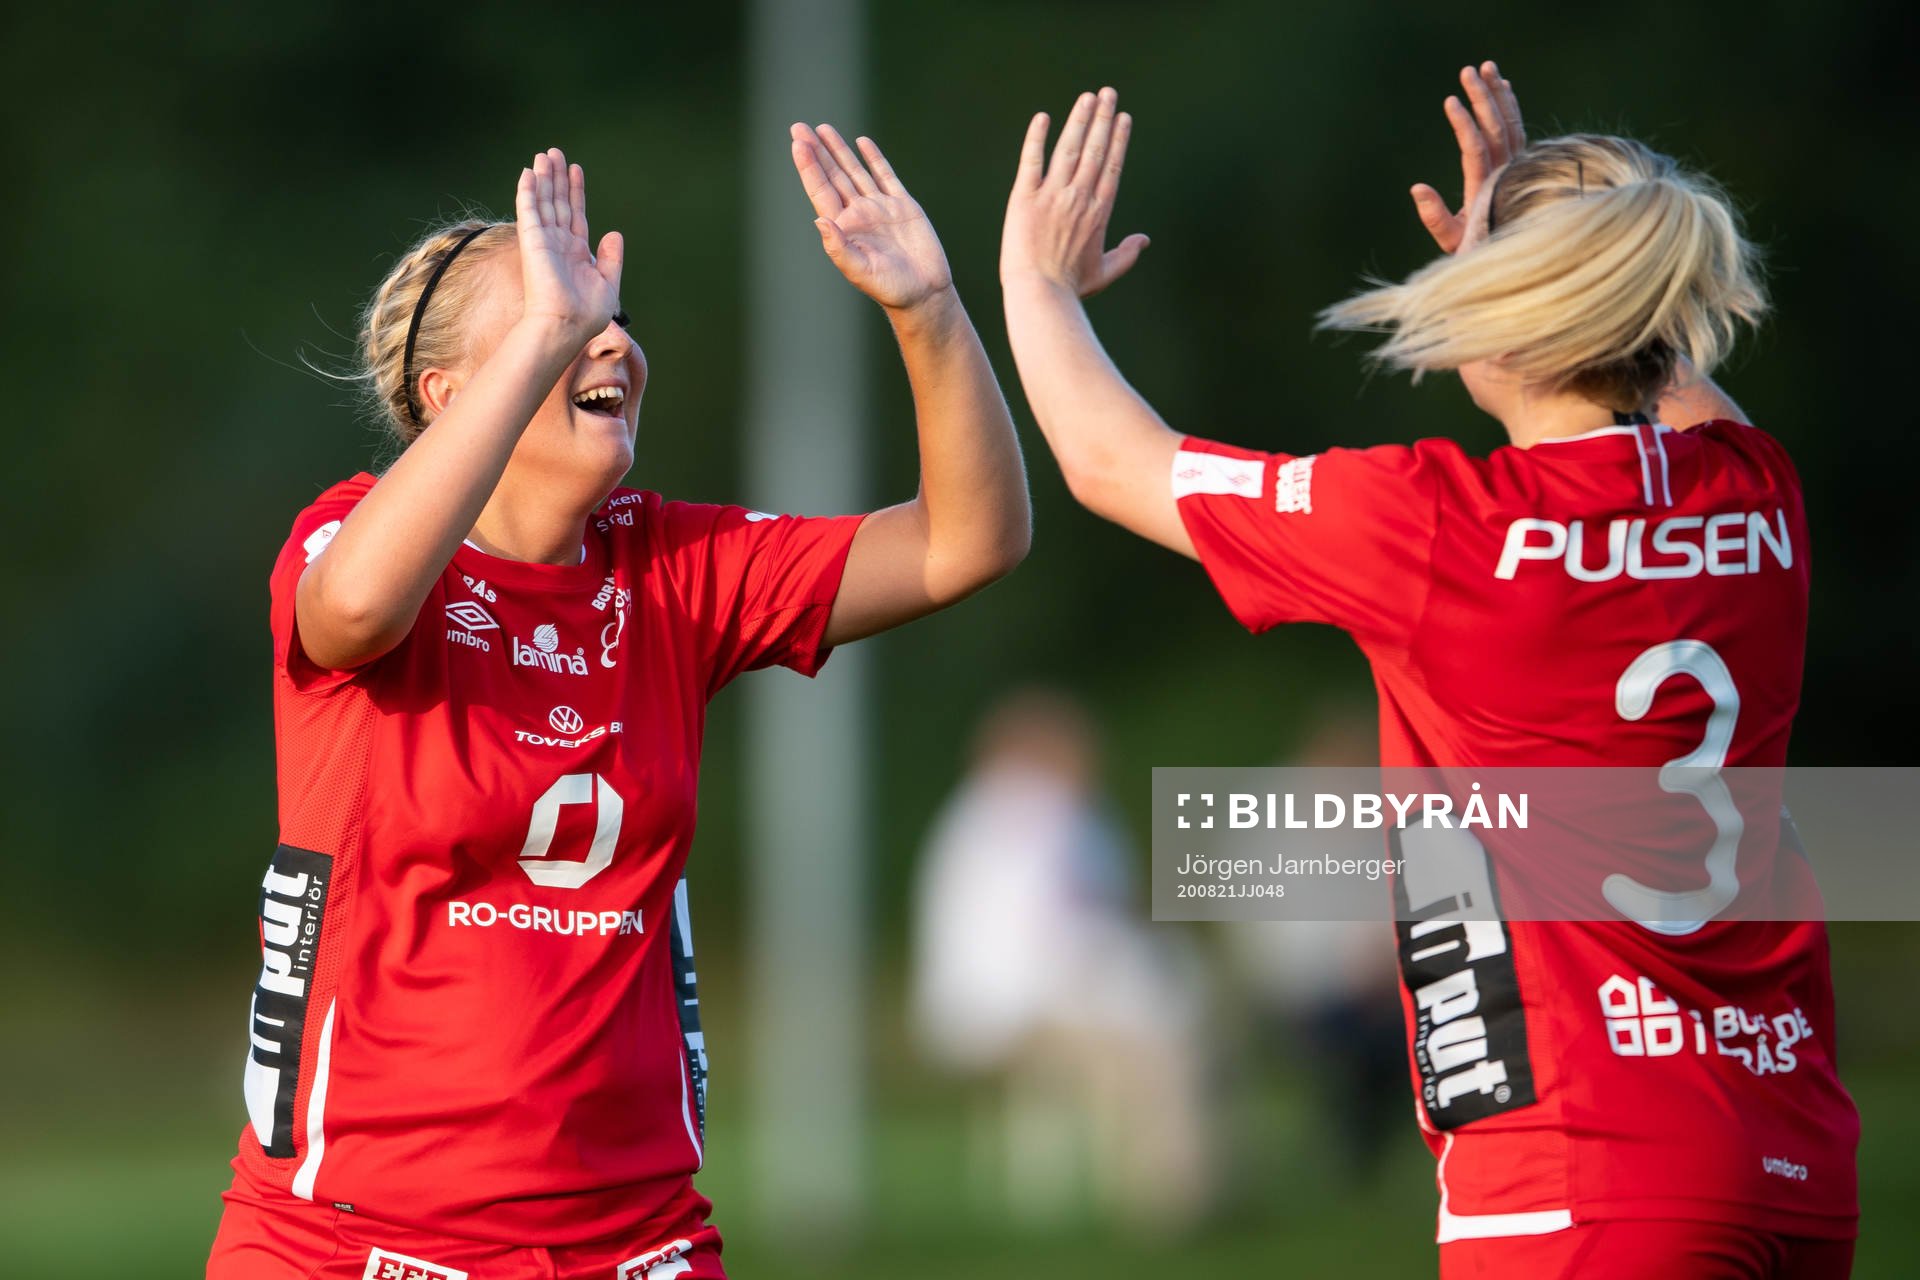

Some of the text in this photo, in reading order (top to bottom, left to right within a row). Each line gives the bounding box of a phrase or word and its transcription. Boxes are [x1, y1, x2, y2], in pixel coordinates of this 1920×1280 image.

[1494, 508, 1793, 582] PULSEN
[1602, 639, 1744, 936] 3
[293, 876, 323, 971] interiör
[448, 901, 644, 936] RO-GRUPPEN
